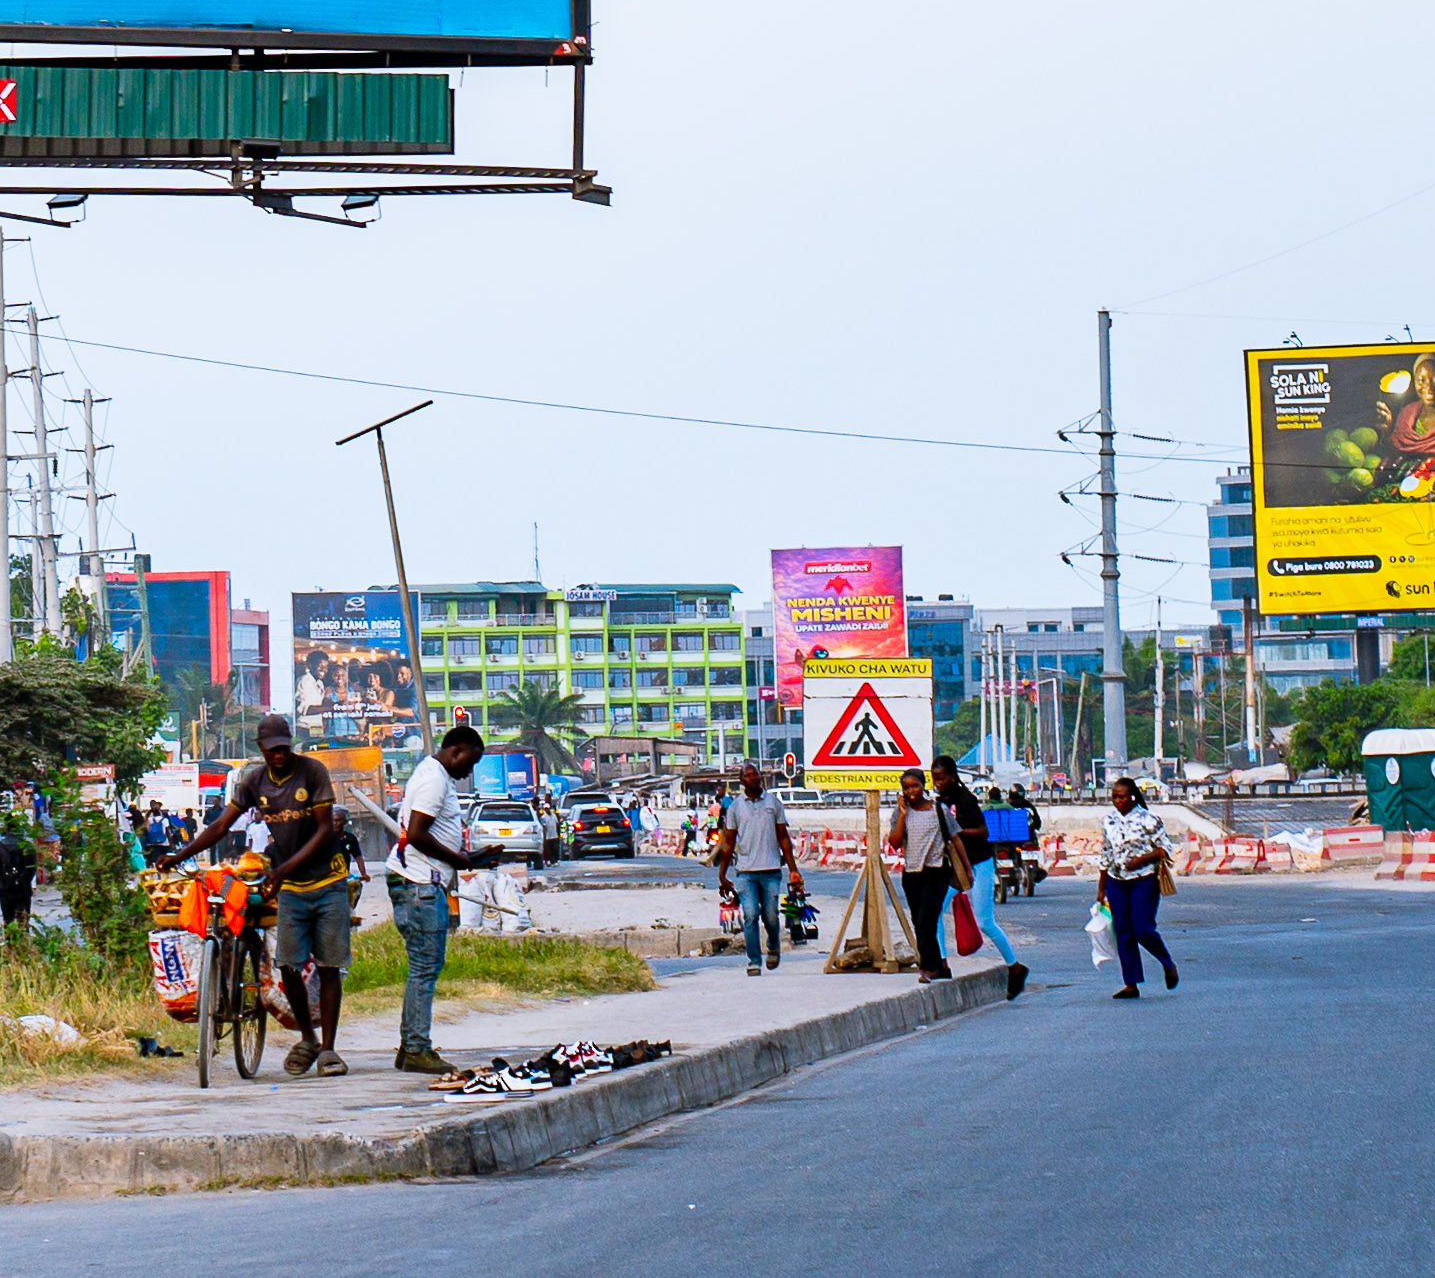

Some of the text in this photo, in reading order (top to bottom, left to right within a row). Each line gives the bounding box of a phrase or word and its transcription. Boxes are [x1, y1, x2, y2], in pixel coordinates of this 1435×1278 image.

[1270, 370, 1323, 388] SOLA NI
[1277, 382, 1331, 398] SUN KING
[807, 563, 869, 573] meridianbet
[592, 591, 615, 599] HOUSE
[1405, 584, 1430, 595] sun
[786, 595, 895, 607] NENDA KWENYE
[791, 606, 891, 622] MISHENI
[310, 621, 340, 630] BONGO
[371, 620, 401, 629] BONGO
[795, 624, 823, 632] UPATE
[807, 663, 927, 674] KIVUKO CHA WATU
[806, 775, 872, 784] PEDESTRIAN
